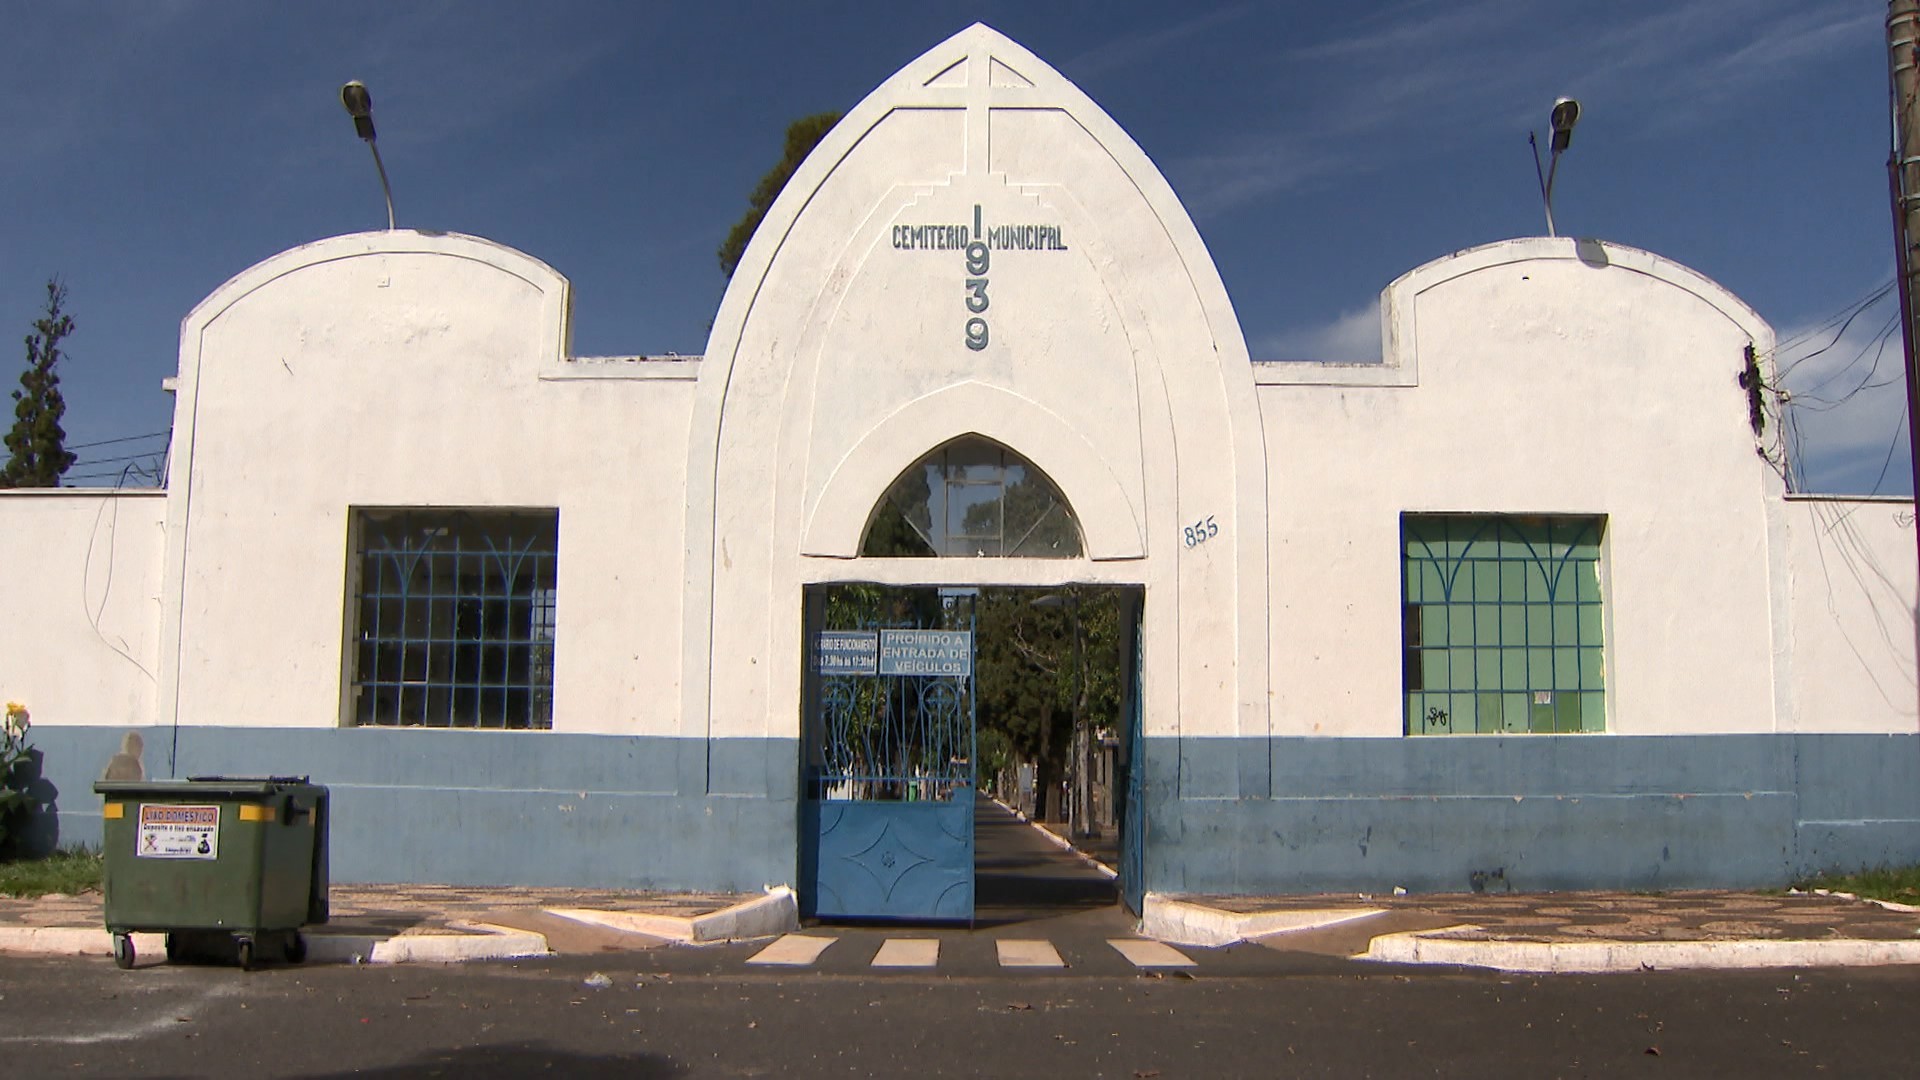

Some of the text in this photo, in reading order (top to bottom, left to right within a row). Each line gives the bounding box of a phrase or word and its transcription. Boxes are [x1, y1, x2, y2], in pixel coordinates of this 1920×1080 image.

[892, 225, 1068, 250] CEMITERIO MUNICIPAL
[1184, 514, 1218, 549] 855
[954, 635, 963, 647] A
[883, 647, 967, 659] ENTRADA DE
[895, 660, 961, 673] VEÍCULOS
